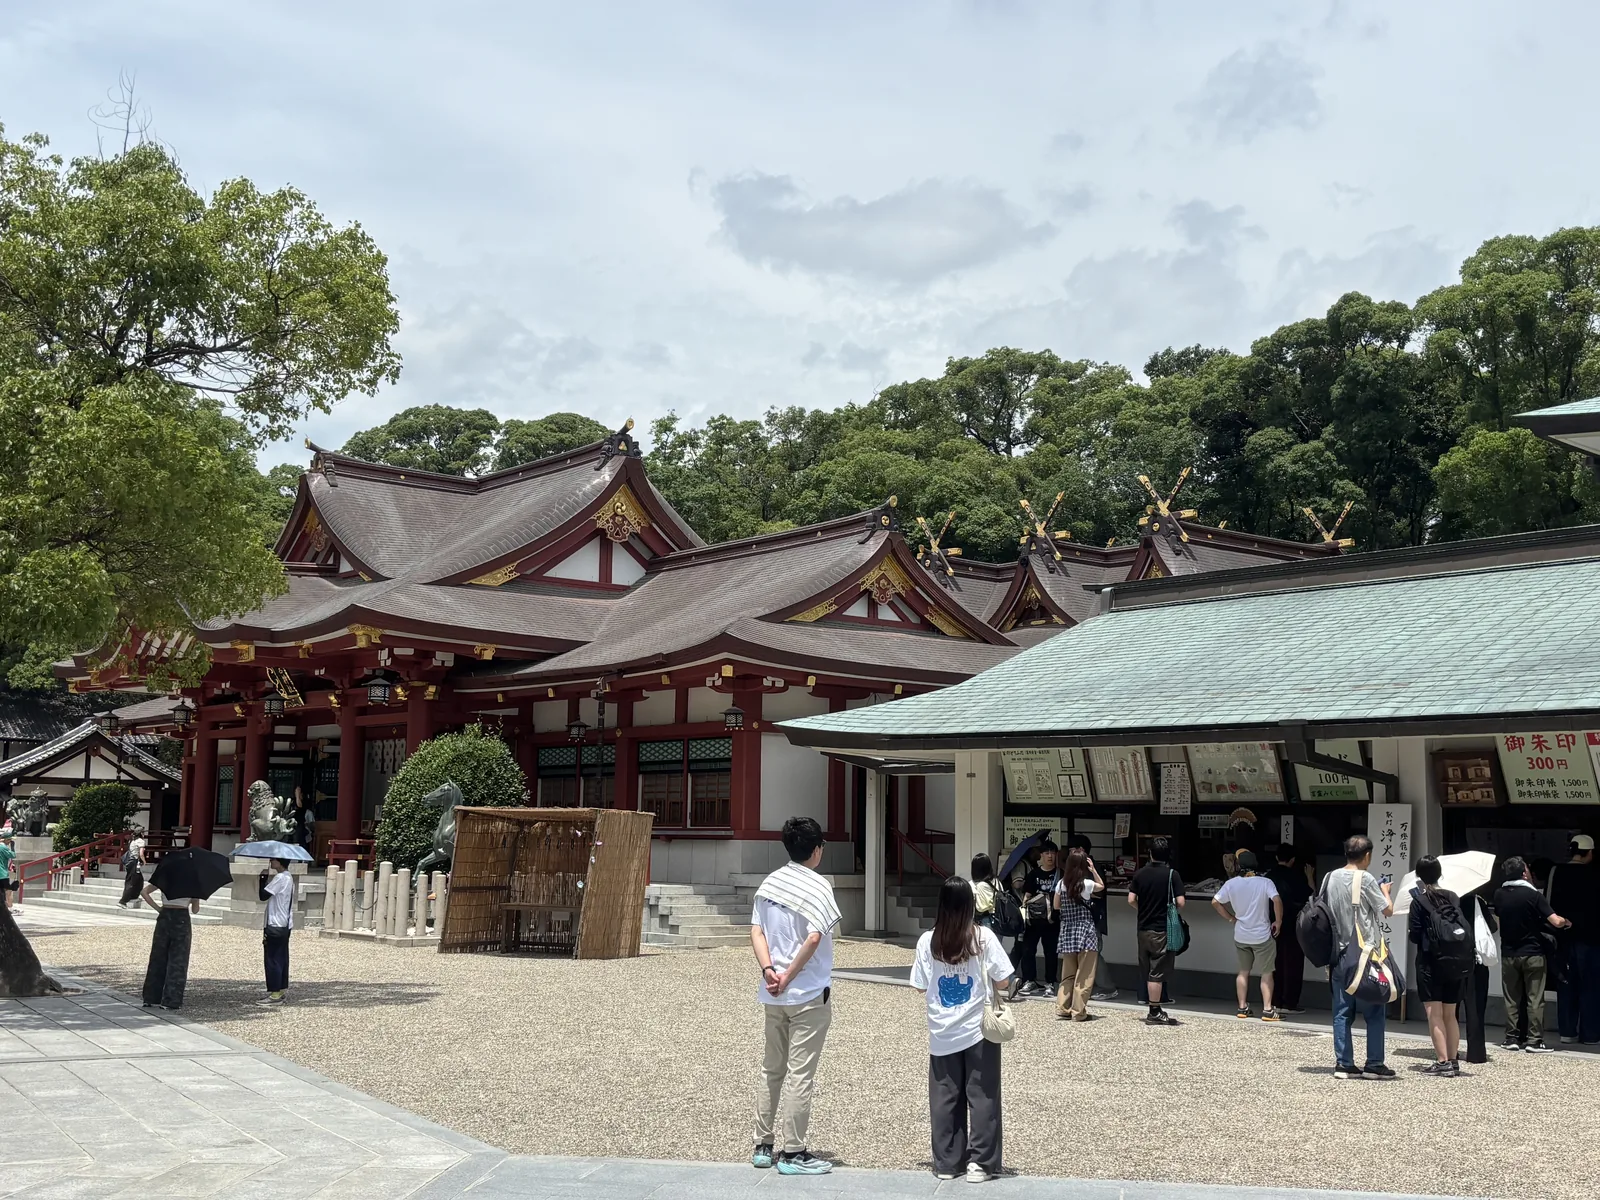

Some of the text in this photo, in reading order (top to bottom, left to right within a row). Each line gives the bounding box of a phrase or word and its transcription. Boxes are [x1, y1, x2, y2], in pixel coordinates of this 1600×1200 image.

[1504, 733, 1576, 753] 御朱印
[1526, 757, 1568, 770] 300円
[1515, 778, 1588, 787] 御朱印帳 1,500円
[1565, 791, 1591, 799] 1,500円
